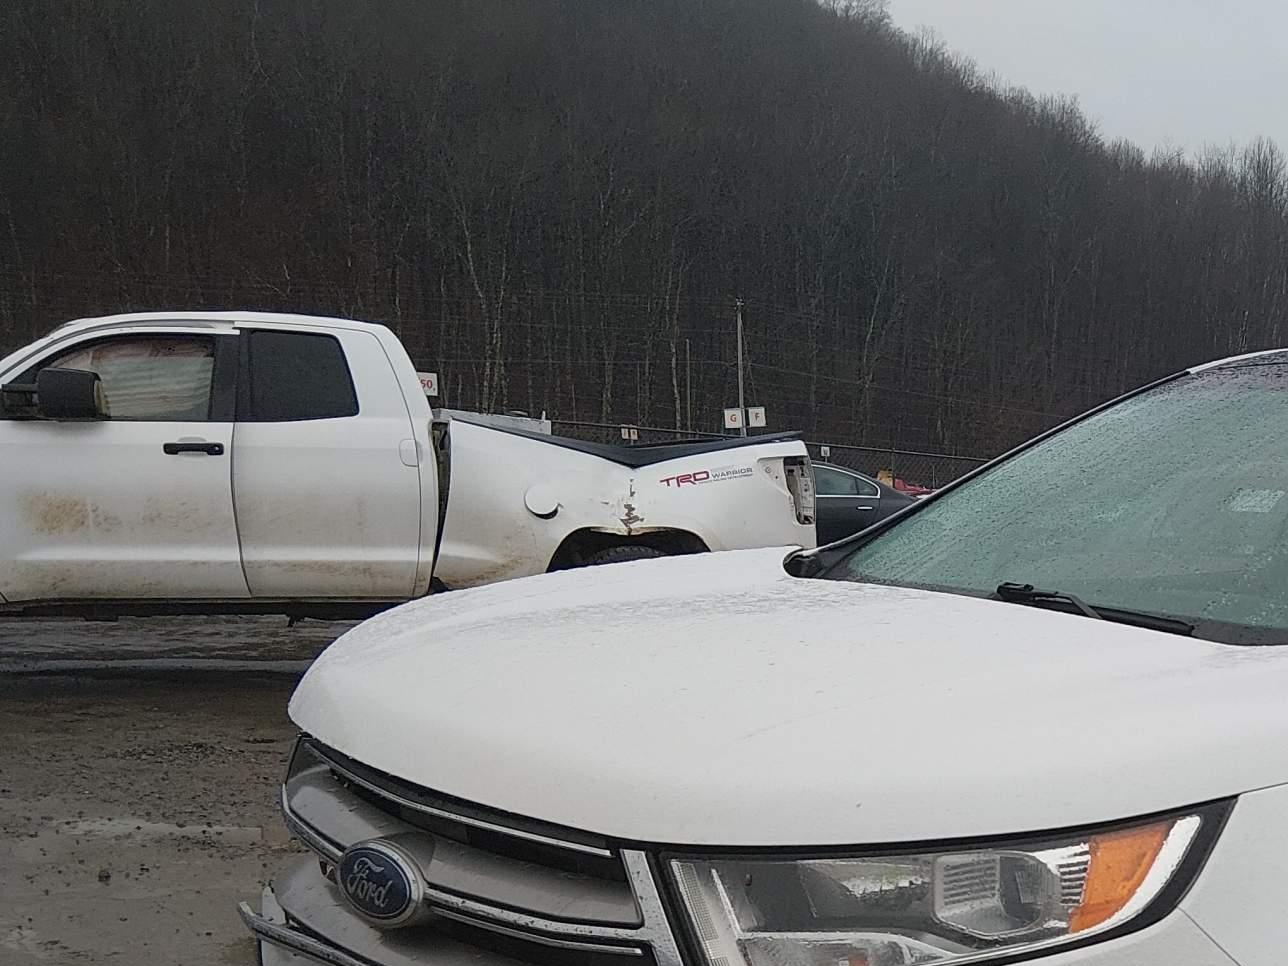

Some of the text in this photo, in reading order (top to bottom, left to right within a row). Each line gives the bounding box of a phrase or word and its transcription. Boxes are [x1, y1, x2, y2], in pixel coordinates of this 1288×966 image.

[730, 414, 737, 423] G
[754, 412, 761, 421] F
[660, 470, 710, 488] TRD
[347, 856, 394, 908] Ford
